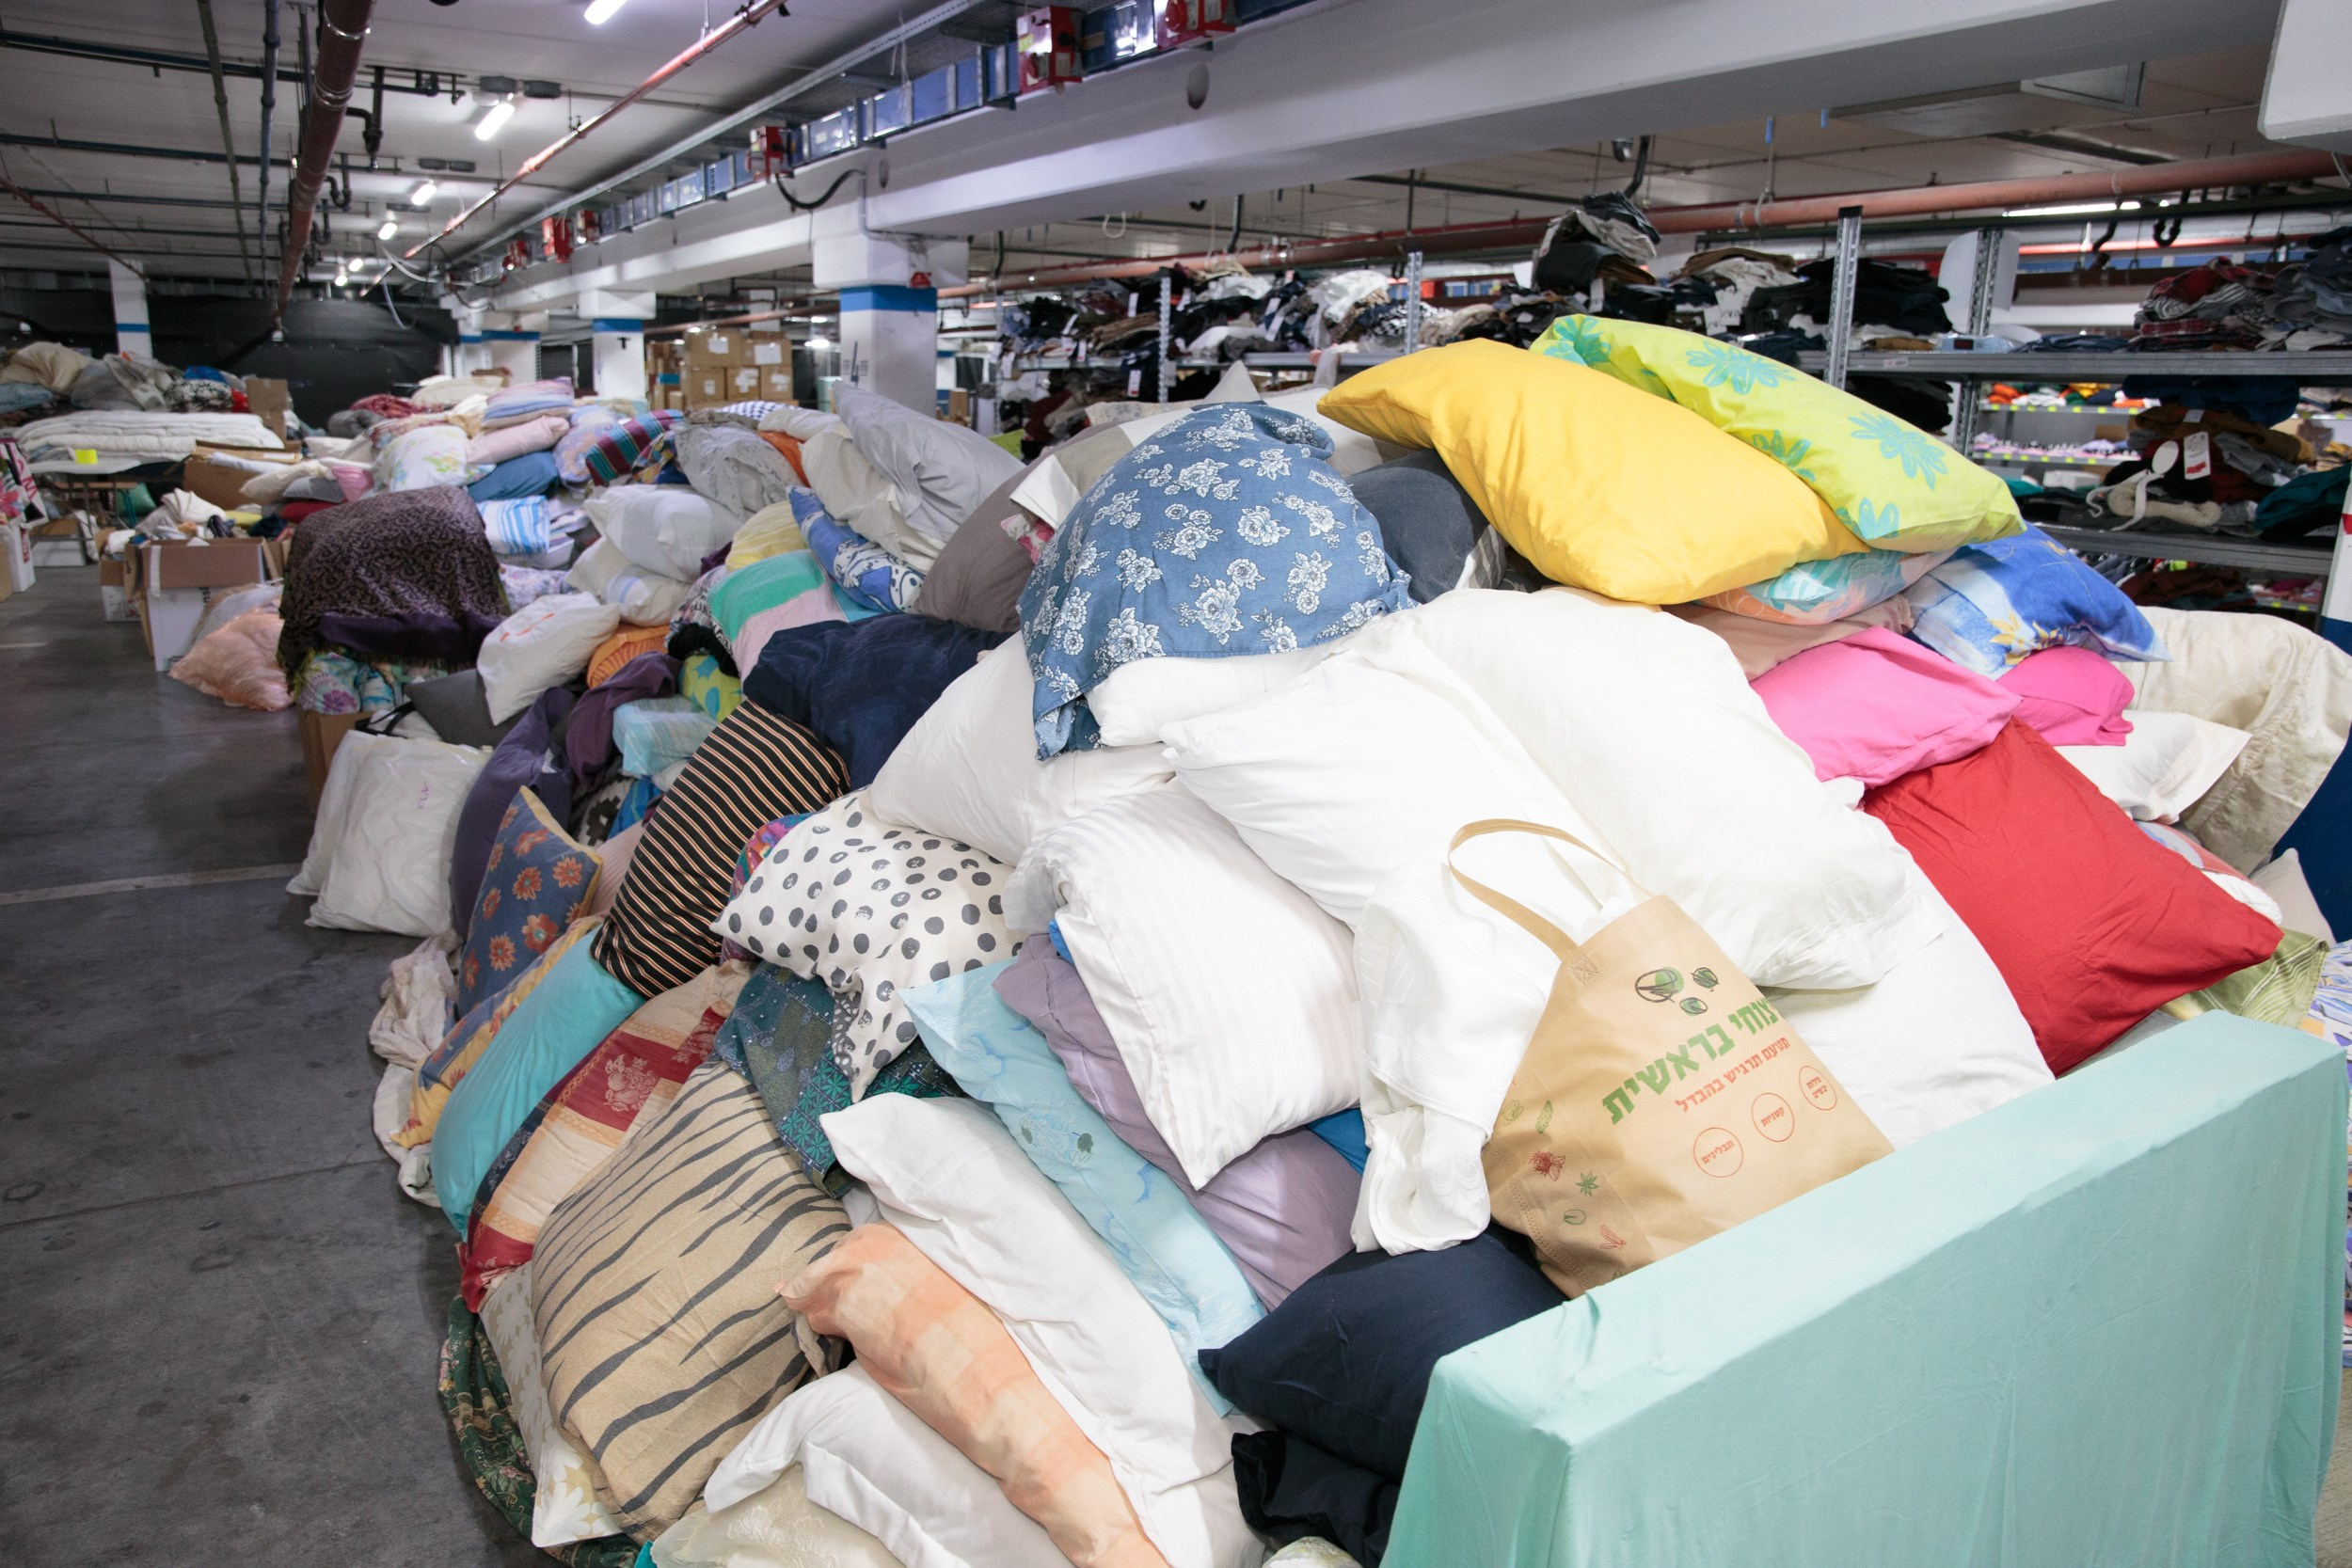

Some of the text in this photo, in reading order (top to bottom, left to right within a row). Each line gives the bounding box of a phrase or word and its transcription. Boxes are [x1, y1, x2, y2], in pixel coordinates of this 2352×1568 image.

[1601, 998, 1778, 1125] צוחי בראשית
[1675, 1037, 1790, 1113] תטעם תרגיש בהבדל
[1760, 1106, 1785, 1127] קטניות
[1701, 1140, 1735, 1164] תבלינים
